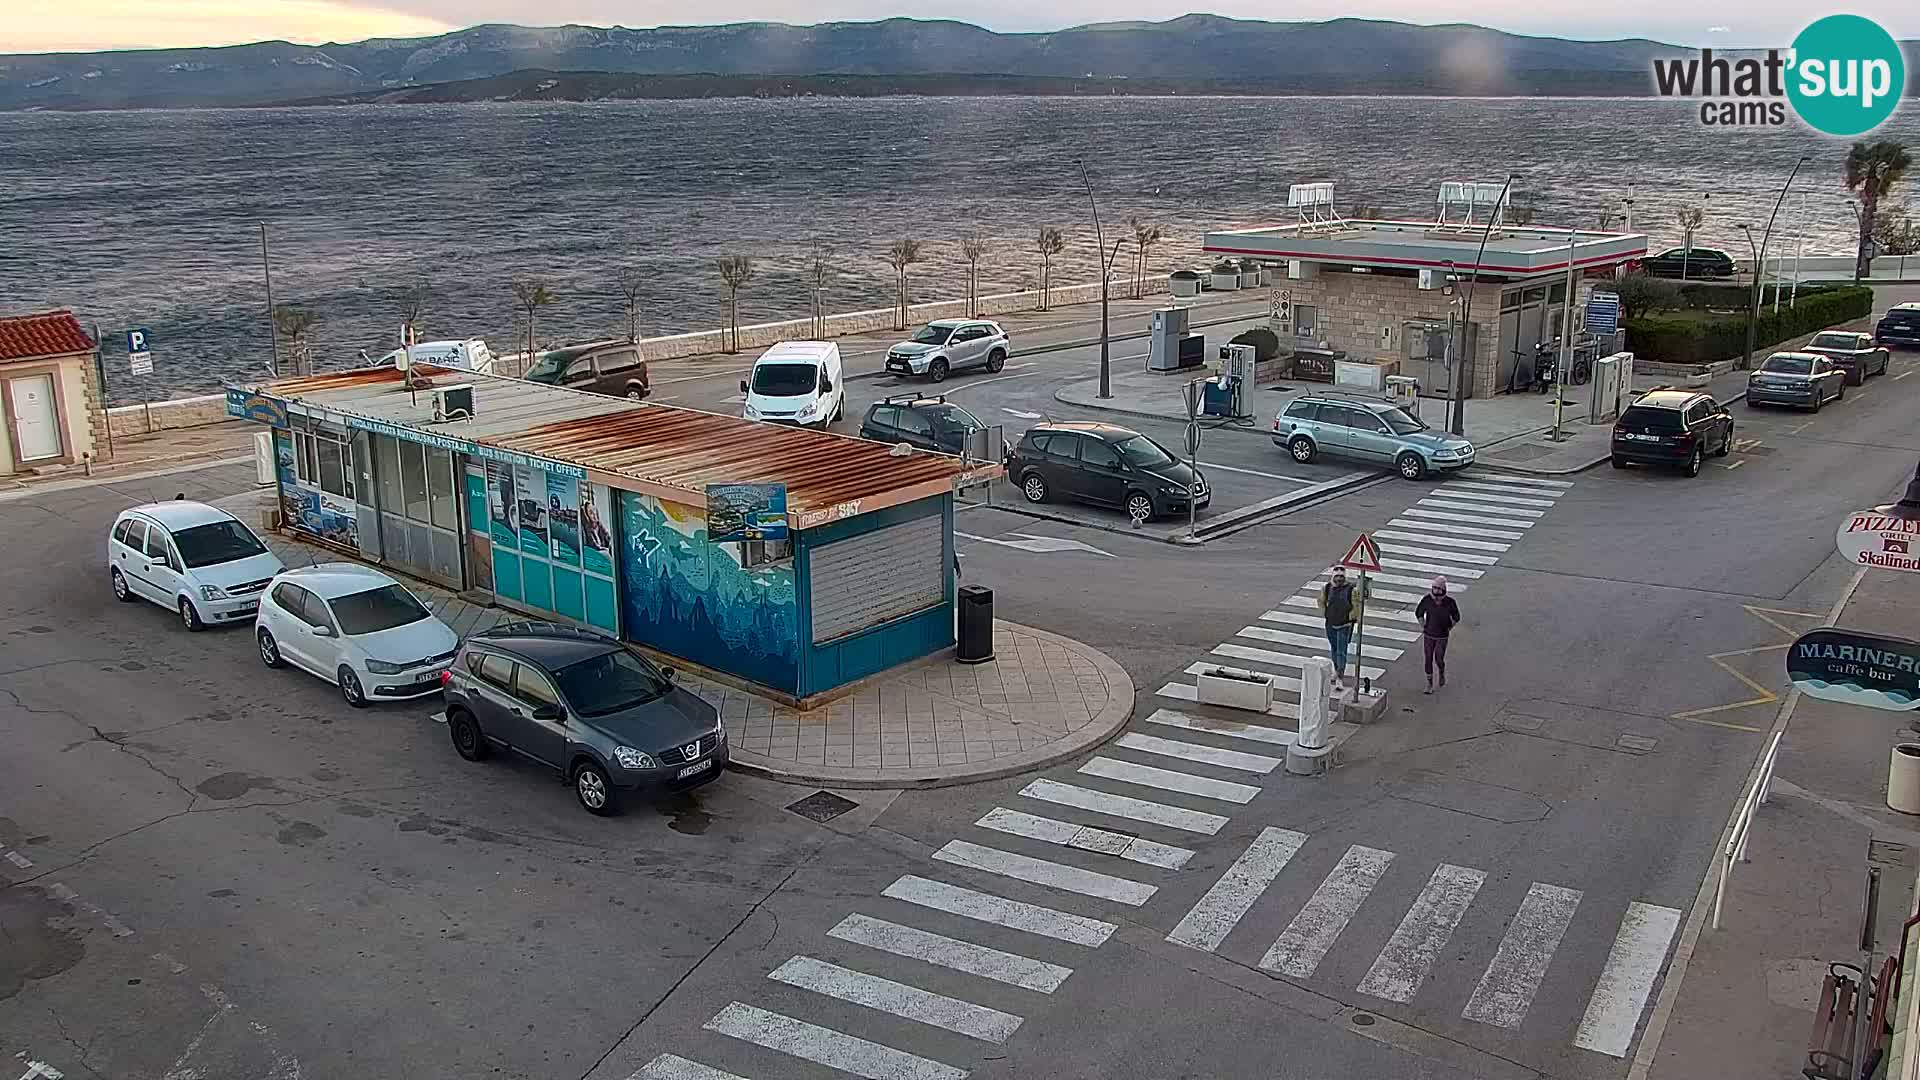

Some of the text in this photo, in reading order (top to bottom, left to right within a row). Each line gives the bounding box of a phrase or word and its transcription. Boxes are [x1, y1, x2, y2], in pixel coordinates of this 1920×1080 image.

[131, 331, 144, 350] P
[437, 437, 469, 453] POSTAJA
[479, 446, 493, 459] BUS
[494, 449, 527, 466] STATION
[529, 457, 555, 472] TICKET
[556, 462, 583, 477] OFFICE
[1880, 531, 1915, 542] GRILL
[1828, 663, 1896, 681] caffe bar
